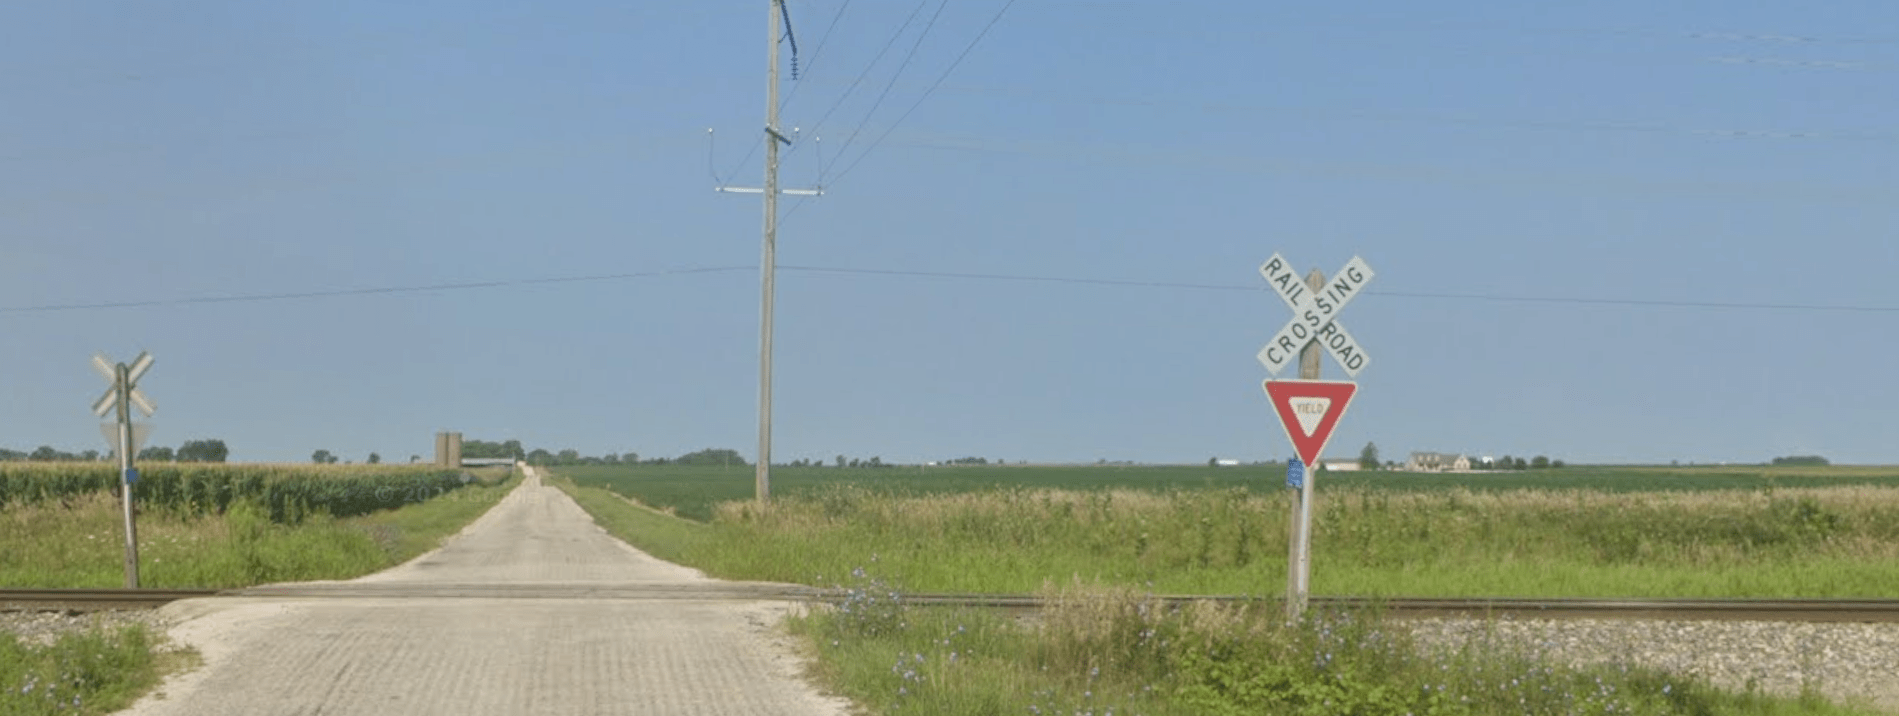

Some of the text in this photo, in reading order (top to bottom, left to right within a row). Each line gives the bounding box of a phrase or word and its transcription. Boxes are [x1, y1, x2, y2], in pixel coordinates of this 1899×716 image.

[1264, 257, 1363, 370] RAIL ROAD
[1267, 266, 1363, 364] CROSSING
[1297, 403, 1324, 414] YIELD
